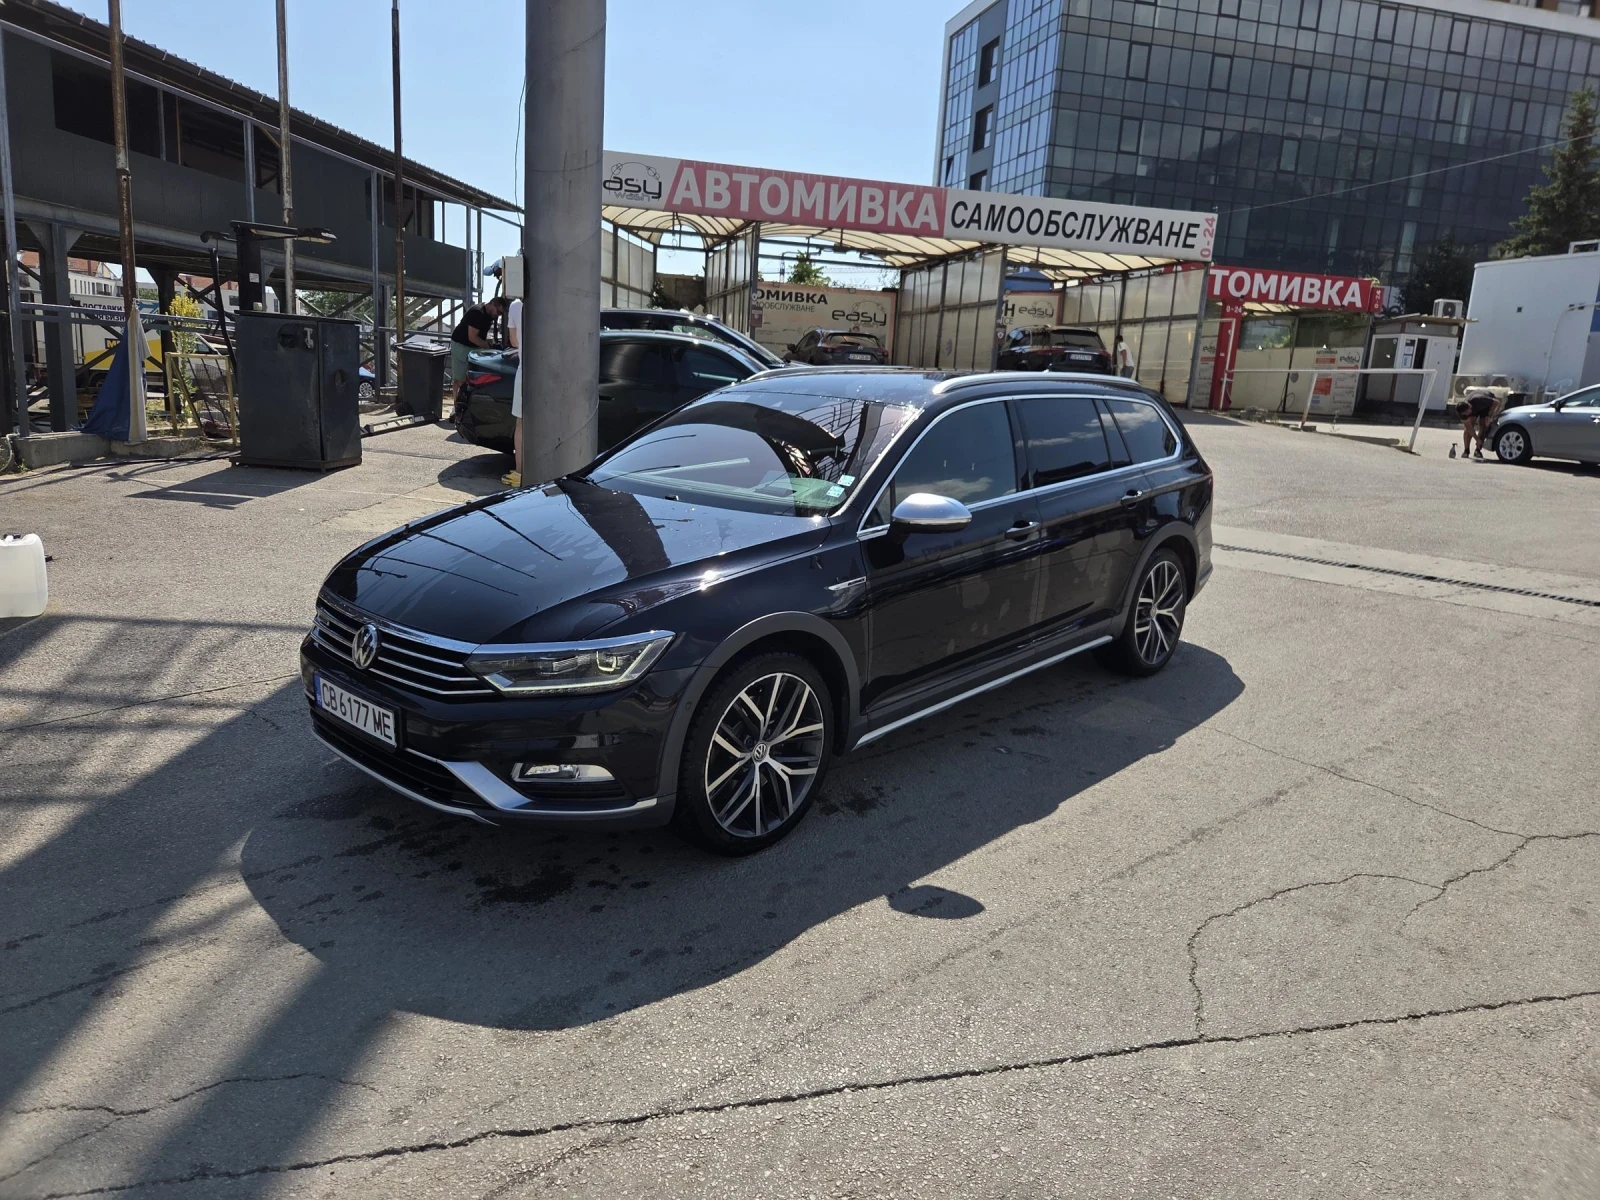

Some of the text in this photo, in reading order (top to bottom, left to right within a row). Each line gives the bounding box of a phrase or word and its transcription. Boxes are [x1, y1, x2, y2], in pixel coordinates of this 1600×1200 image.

[602, 176, 662, 199] asy
[671, 167, 940, 231] АВТОМИВКА
[951, 201, 1200, 249] САМООБСЛУЖВАНЕ
[1200, 216, 1216, 258] 0-24
[757, 288, 828, 305] ОМИВКА
[1209, 268, 1362, 308] ТОМИВКА
[832, 310, 887, 326] easy
[1018, 306, 1054, 318] easy
[1226, 305, 1242, 313] 0-24
